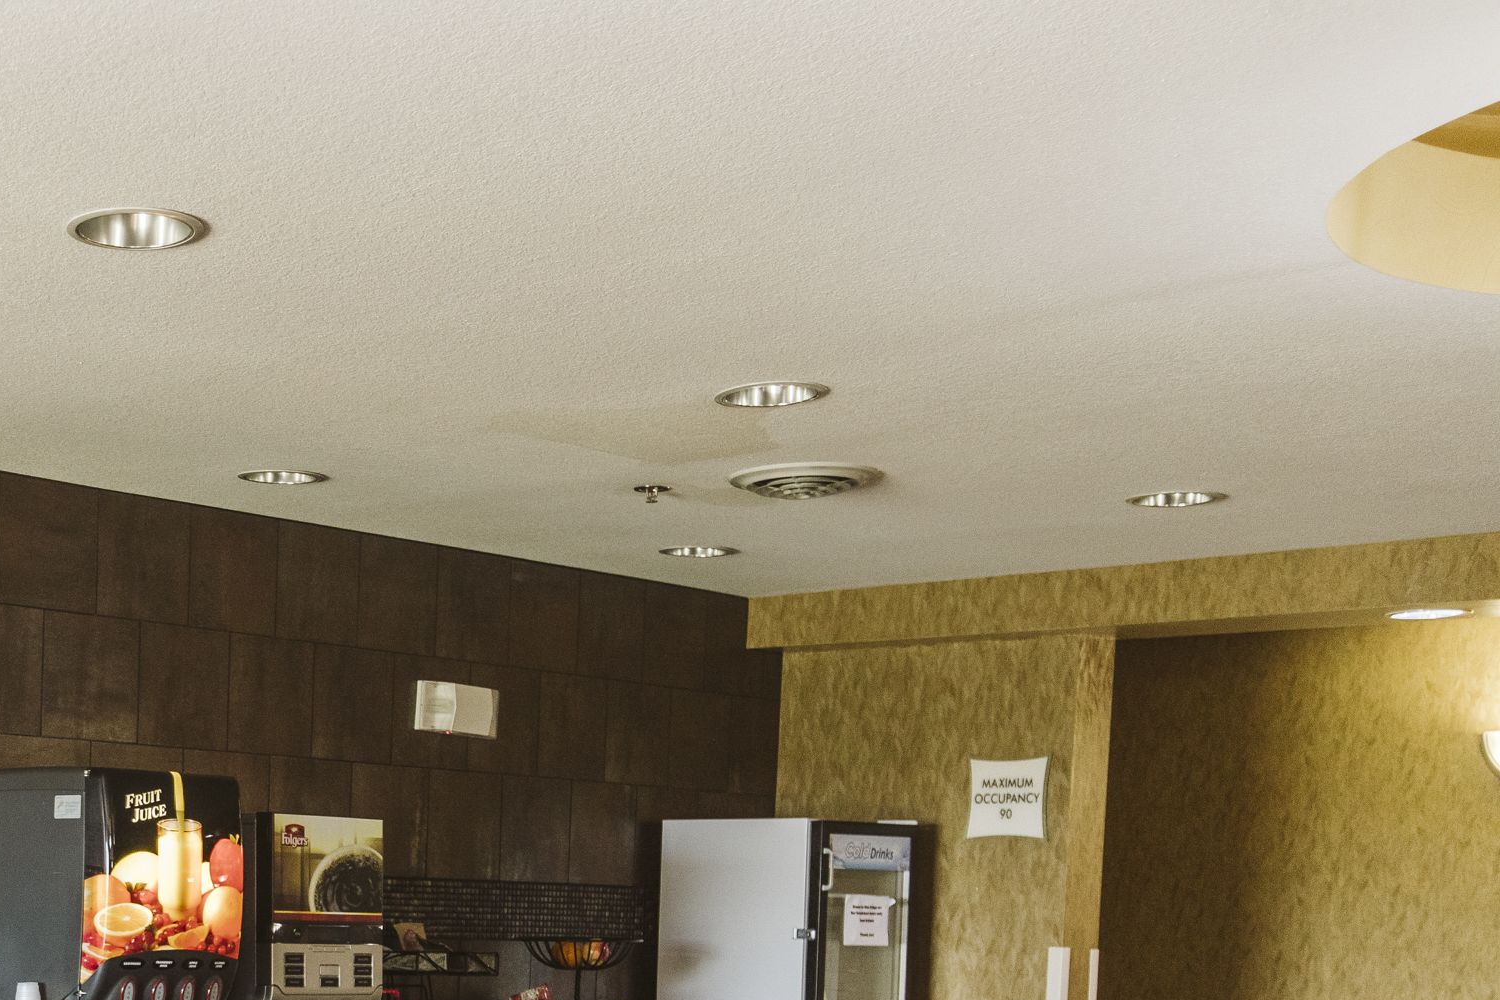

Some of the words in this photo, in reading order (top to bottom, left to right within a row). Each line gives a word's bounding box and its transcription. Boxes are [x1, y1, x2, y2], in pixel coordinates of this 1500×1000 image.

[982, 777, 1034, 789] MAXIMUM
[125, 788, 162, 809] FRUIT
[974, 792, 1040, 805] OCCUPANCY
[131, 803, 167, 823] JUICE
[1000, 808, 1013, 820] 90
[281, 832, 308, 848] Folgers
[845, 841, 872, 860] Cold
[870, 847, 894, 860] Drinks
